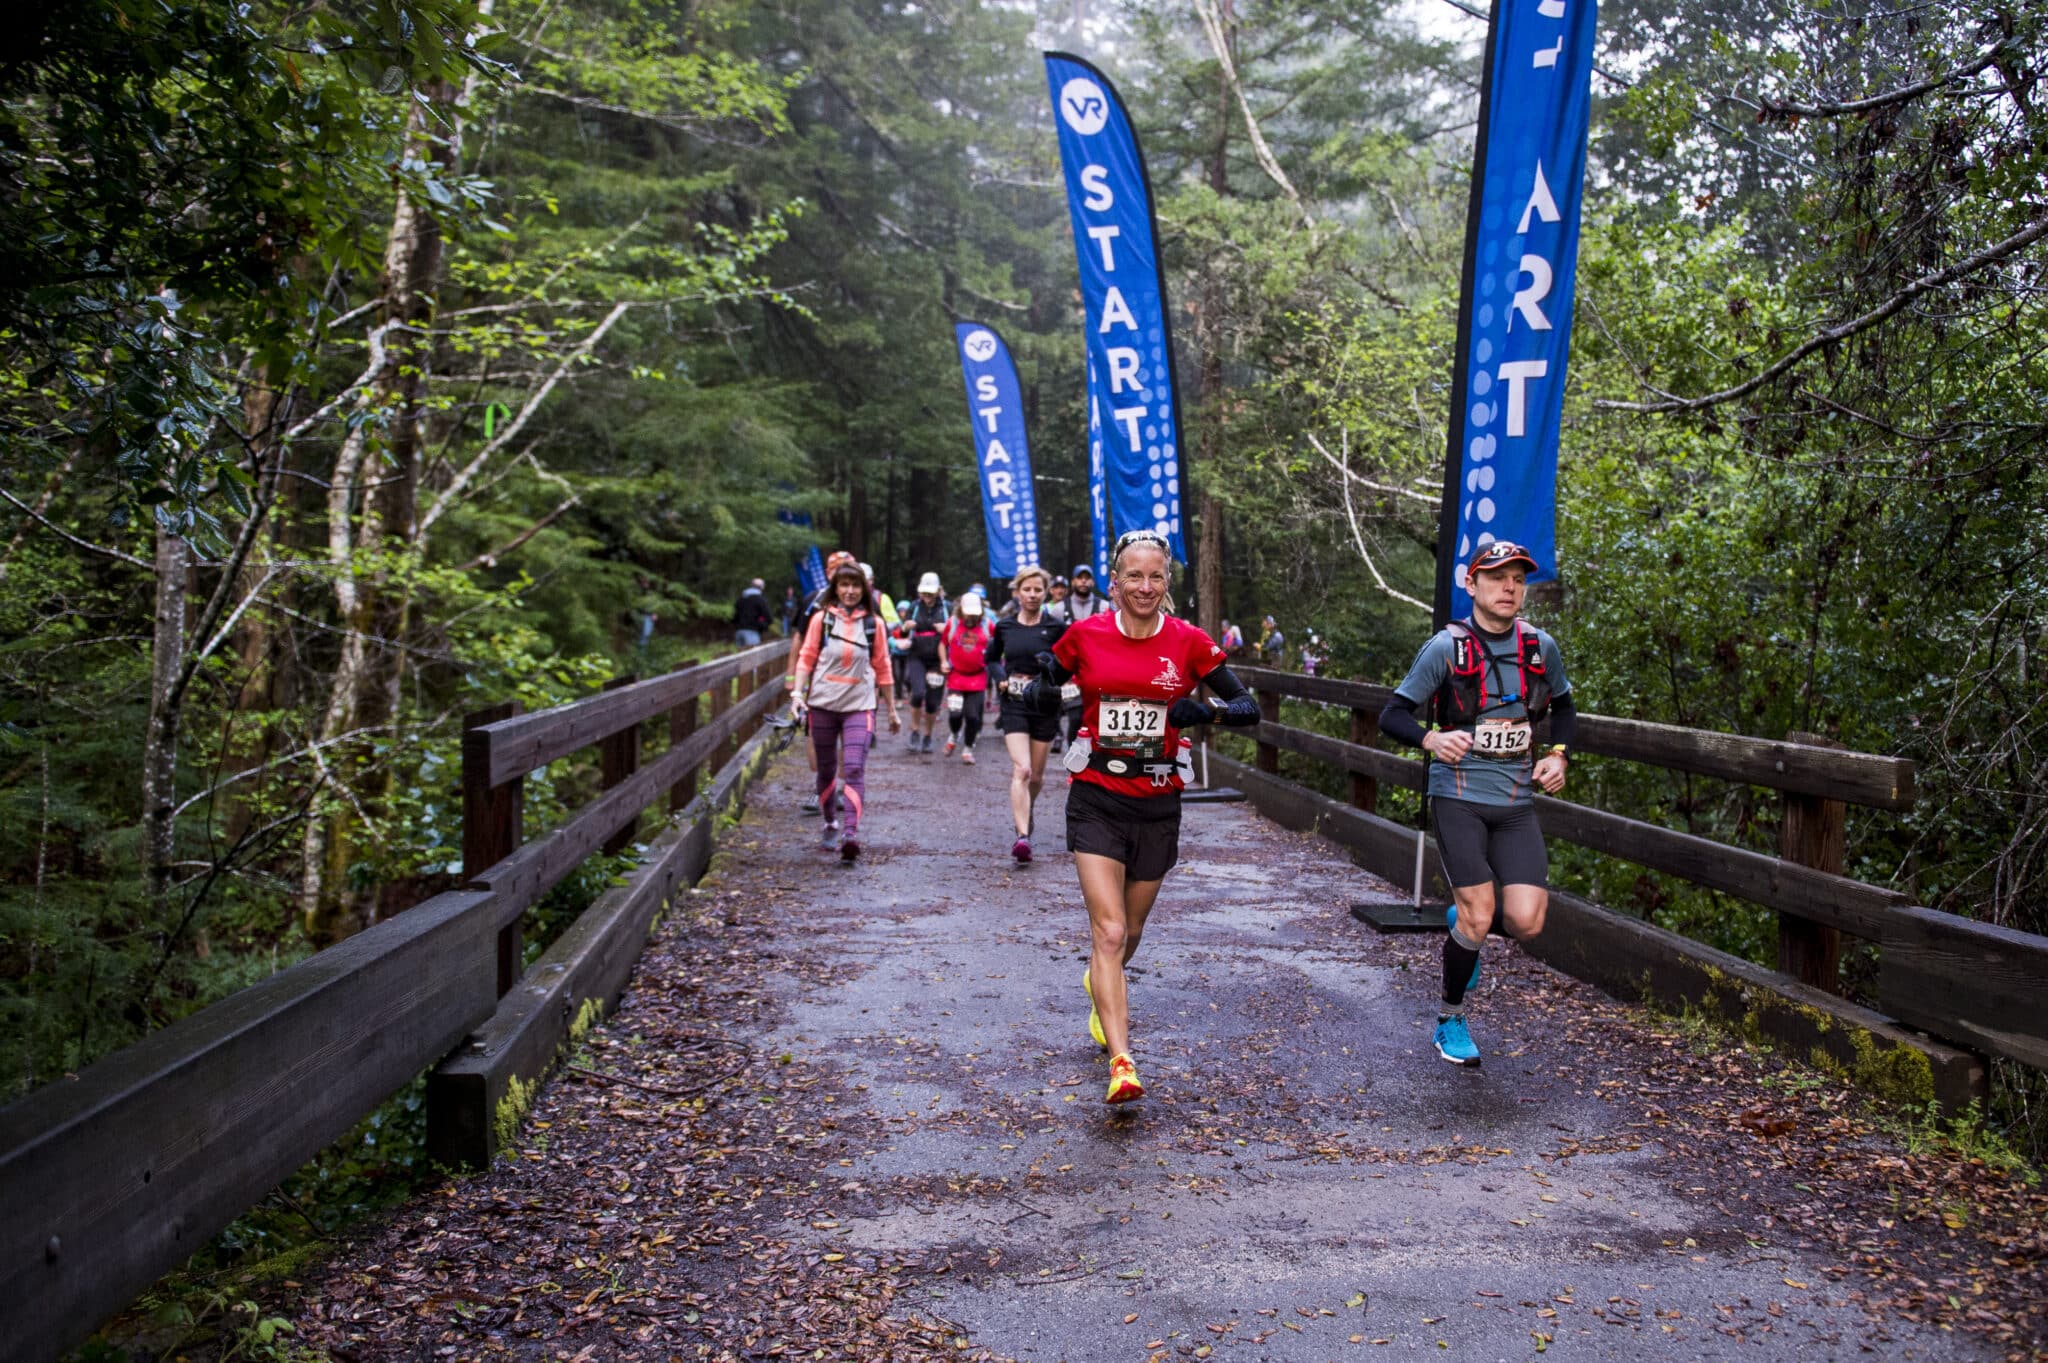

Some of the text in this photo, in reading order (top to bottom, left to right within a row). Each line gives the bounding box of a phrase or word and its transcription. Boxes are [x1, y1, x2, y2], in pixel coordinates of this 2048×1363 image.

[1066, 96, 1103, 121] VR
[1080, 164, 1148, 452] START
[975, 373, 1016, 530] START
[1107, 709, 1158, 731] 3132
[1481, 730, 1526, 749] 3152
